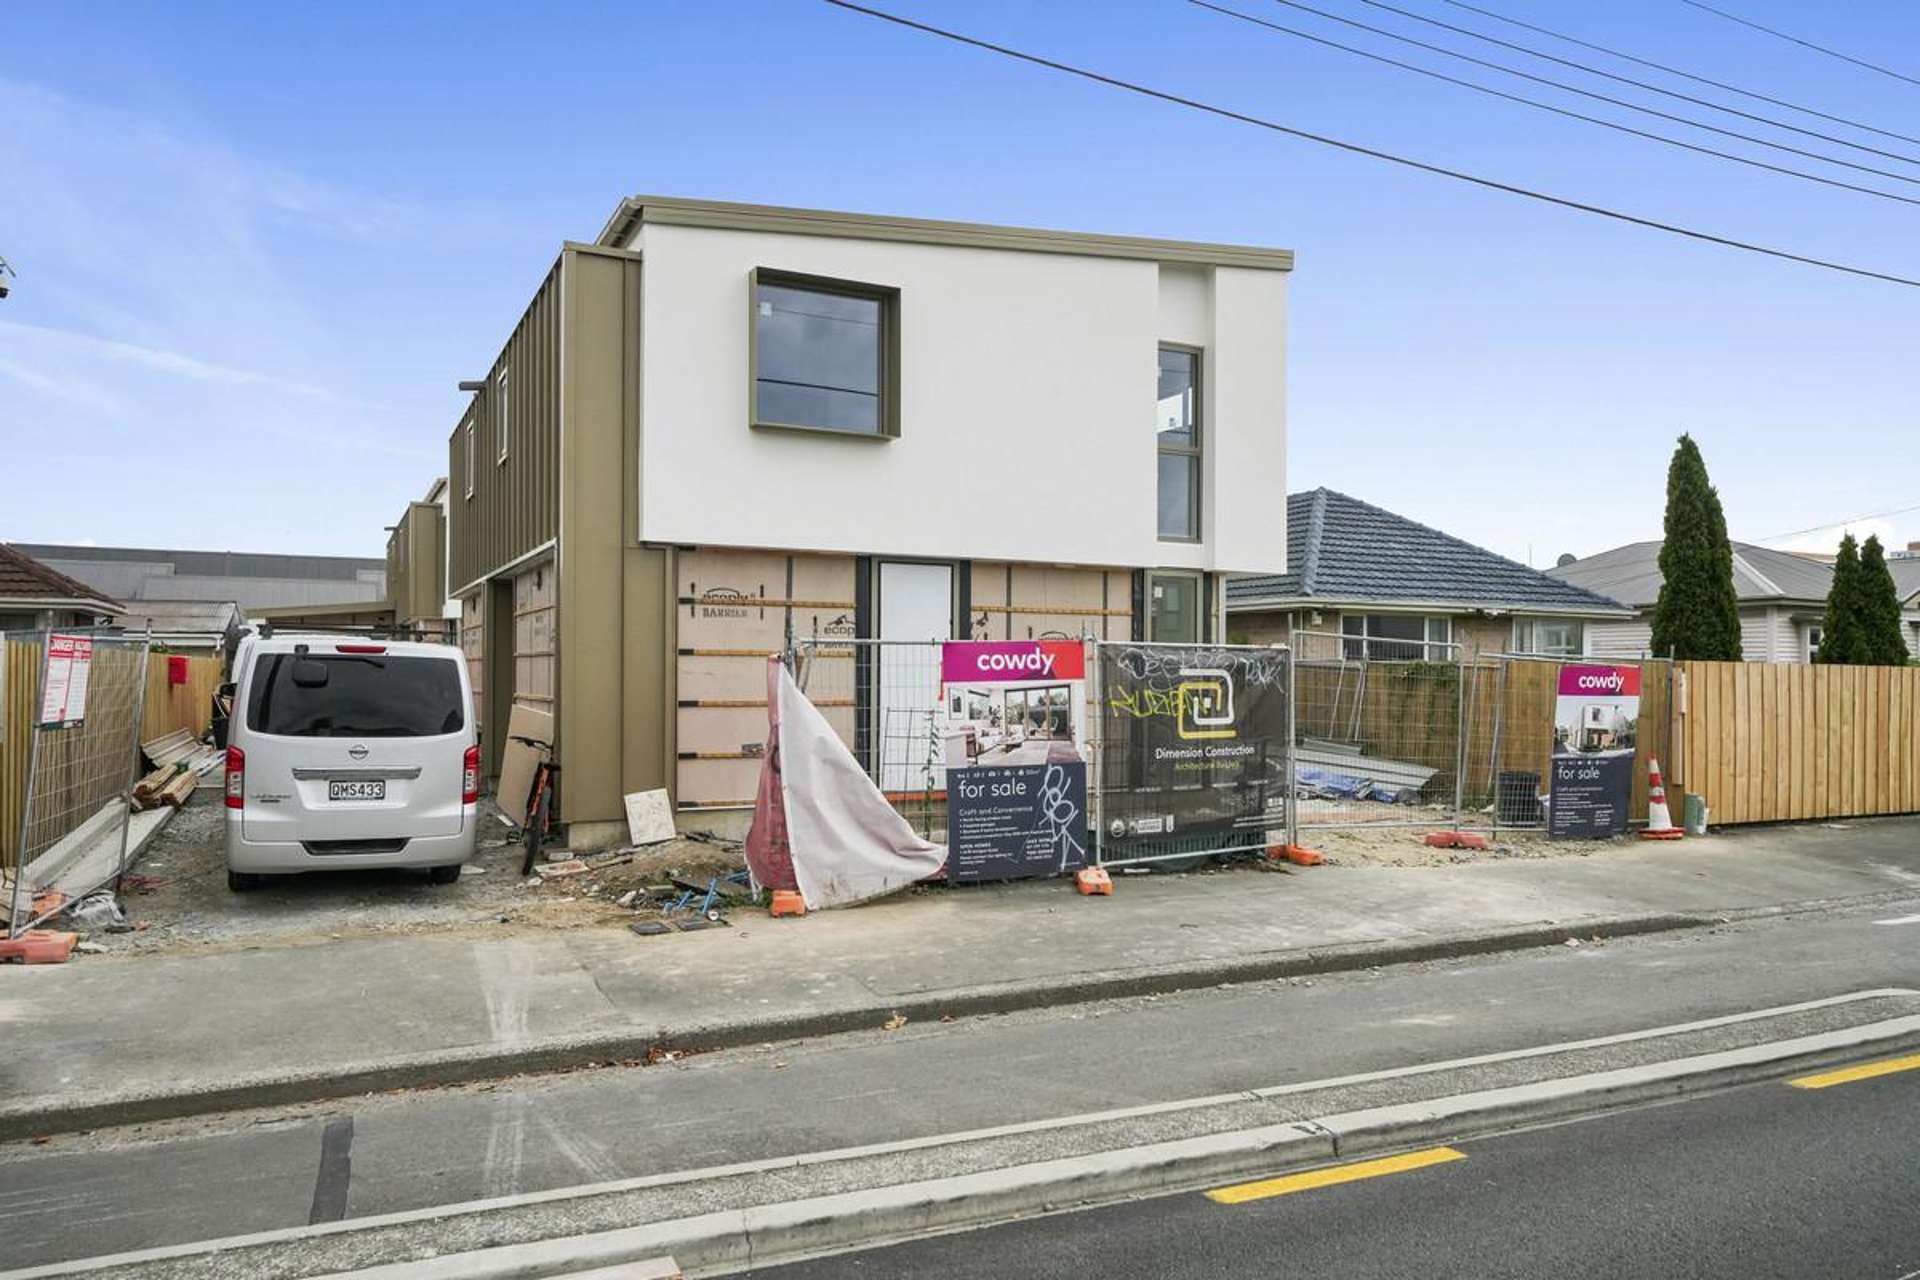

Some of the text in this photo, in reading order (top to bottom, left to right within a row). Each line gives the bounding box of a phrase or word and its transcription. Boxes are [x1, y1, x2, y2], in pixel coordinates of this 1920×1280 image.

[977, 646, 1056, 676] cowdy
[1578, 672, 1625, 692] cowdy
[1155, 745, 1255, 760] Dimension Construction
[1558, 764, 1600, 780] for sale
[332, 783, 383, 797] QMS433
[959, 777, 1027, 798] for sale
